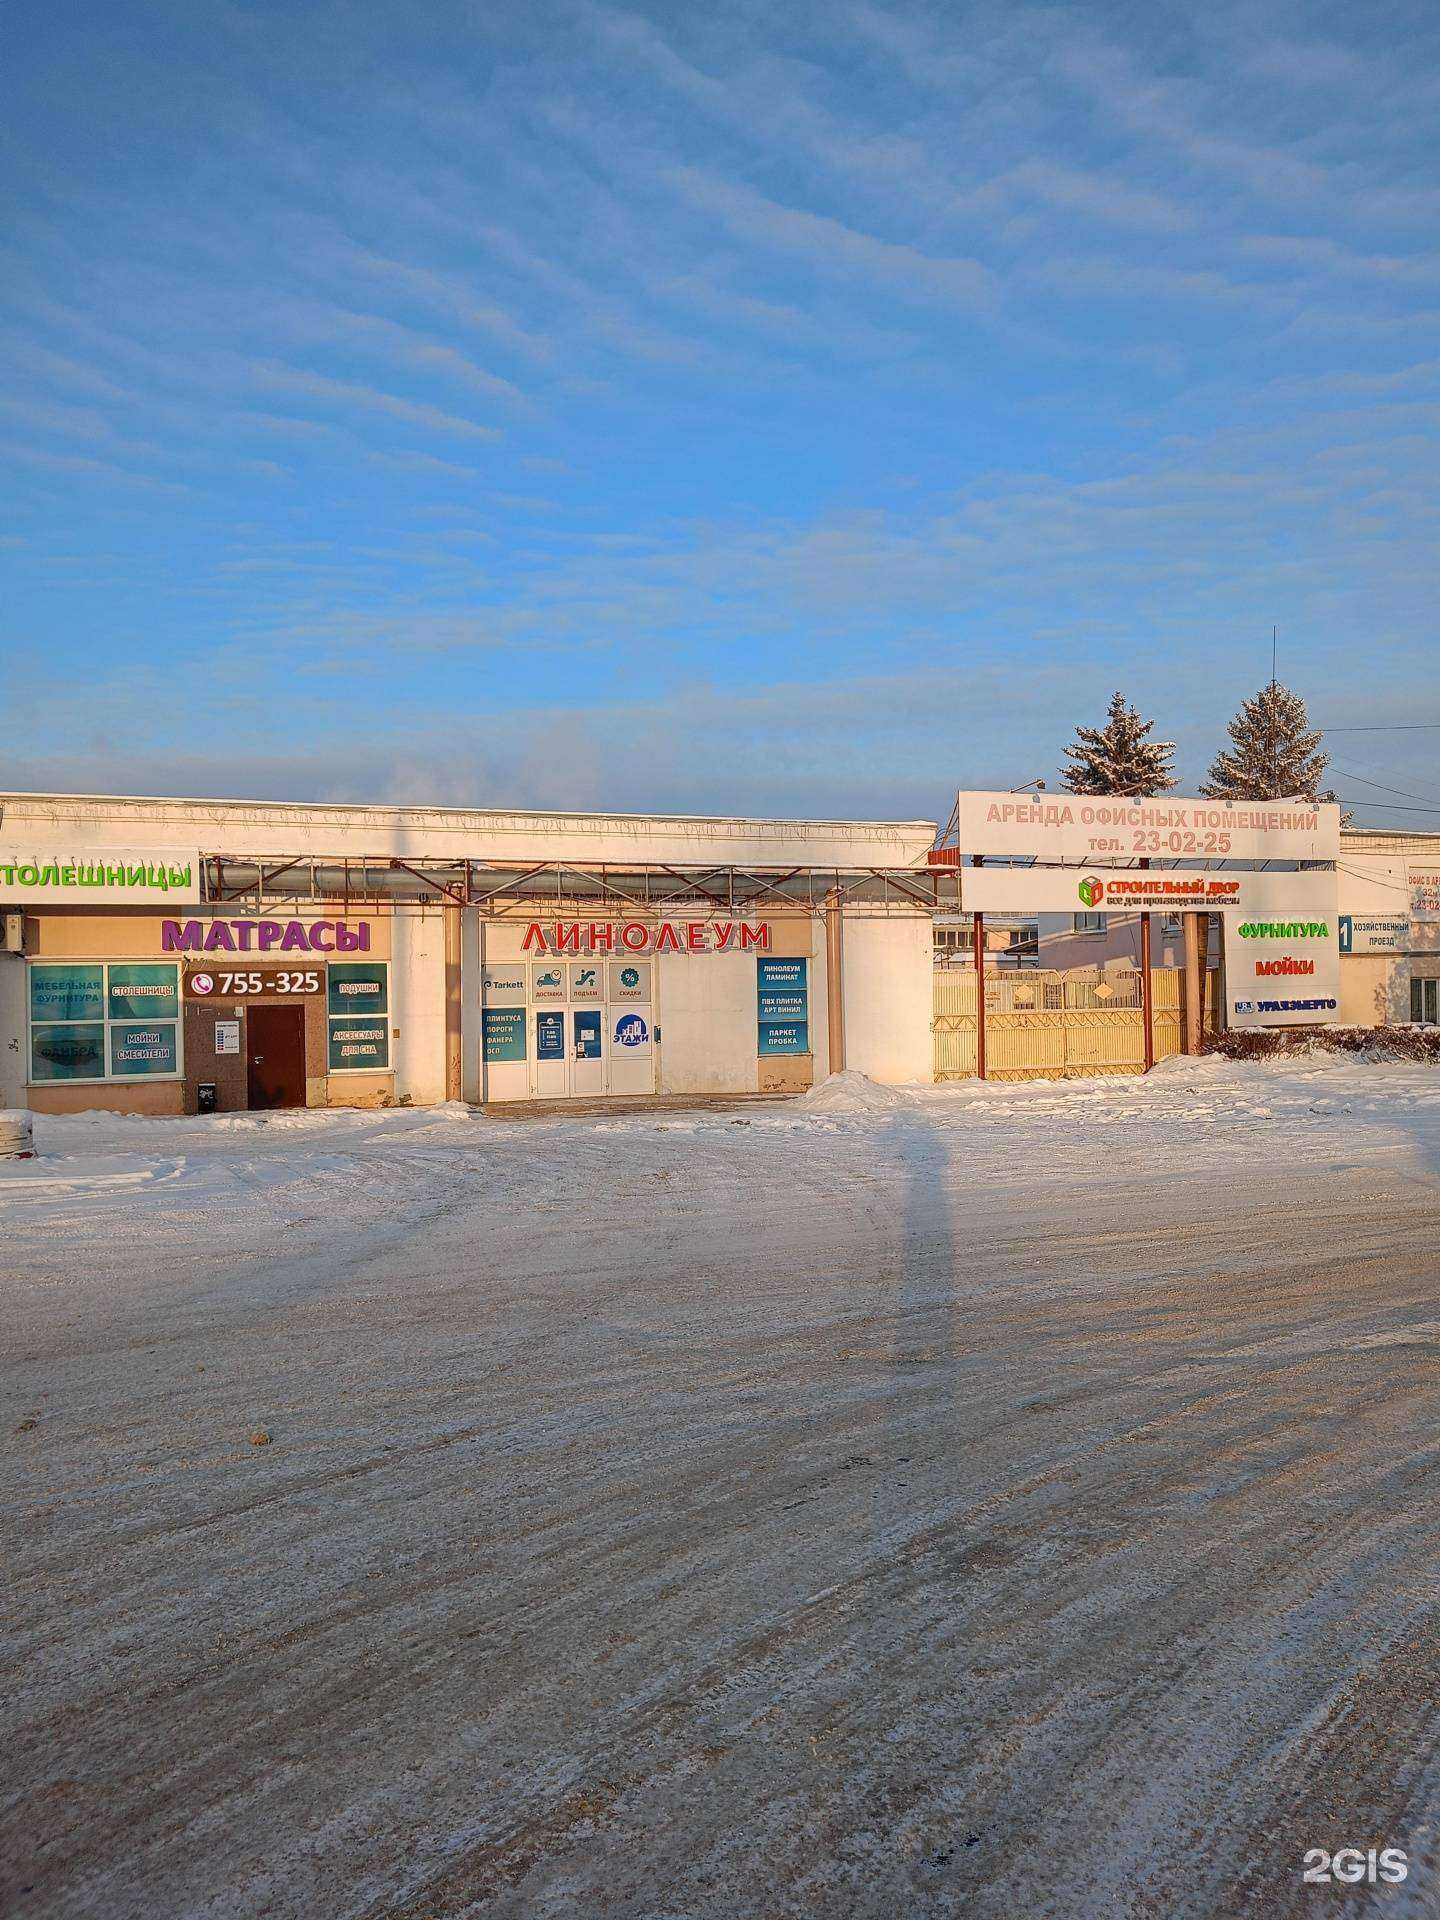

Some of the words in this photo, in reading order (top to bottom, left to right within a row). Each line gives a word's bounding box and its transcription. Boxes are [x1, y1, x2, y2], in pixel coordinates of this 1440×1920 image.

[987, 803, 1074, 825] АРЕНДА
[1081, 807, 1187, 828] ОФИСНЫХ
[1193, 810, 1318, 832] ПОМЕЩЕНИЙ
[1088, 837, 1125, 851] тел.
[1133, 831, 1231, 853] 23-02-25
[0, 864, 192, 892] ТОЛЕШНИЦЫ
[1107, 879, 1205, 894] СТРОИТЕЛЬНЫЙ
[1206, 882, 1240, 896] ДВОР
[1238, 923, 1329, 938] ФУРНИТУРА
[1353, 921, 1409, 931] ХОЗЯЙСТВЕННЫЙ
[161, 920, 370, 952] МАТРАСЫ
[521, 921, 770, 952] ЛИНОЛЕУМ
[1340, 922, 1348, 946] 1
[1369, 937, 1394, 946] ПРОЕЗД
[1255, 956, 1314, 976] МОЙКИ
[35, 982, 101, 991] МЕБЕЛЬНАЯ
[218, 972, 319, 994] 755-325
[339, 983, 379, 994] ПОДУШКИ
[493, 980, 524, 989] Tarkett
[112, 985, 174, 997] СТОЛЕШНИЦЫ
[1257, 999, 1337, 1012] УРАЛЭНЕРГО
[486, 1014, 521, 1022] ПЛИНТУСА
[127, 1032, 160, 1043] МОЙКИ
[333, 1030, 384, 1041] АКСЕССУАРЫ
[486, 1036, 513, 1044] ФАНЕРА
[613, 1034, 649, 1043] ЭТАЖИ
[117, 1049, 169, 1060] СМЕСИТЕЛИ
[341, 1046, 360, 1056] ДЛЯ
[361, 1045, 377, 1055] СНА
[486, 1047, 500, 1055] ОСП
